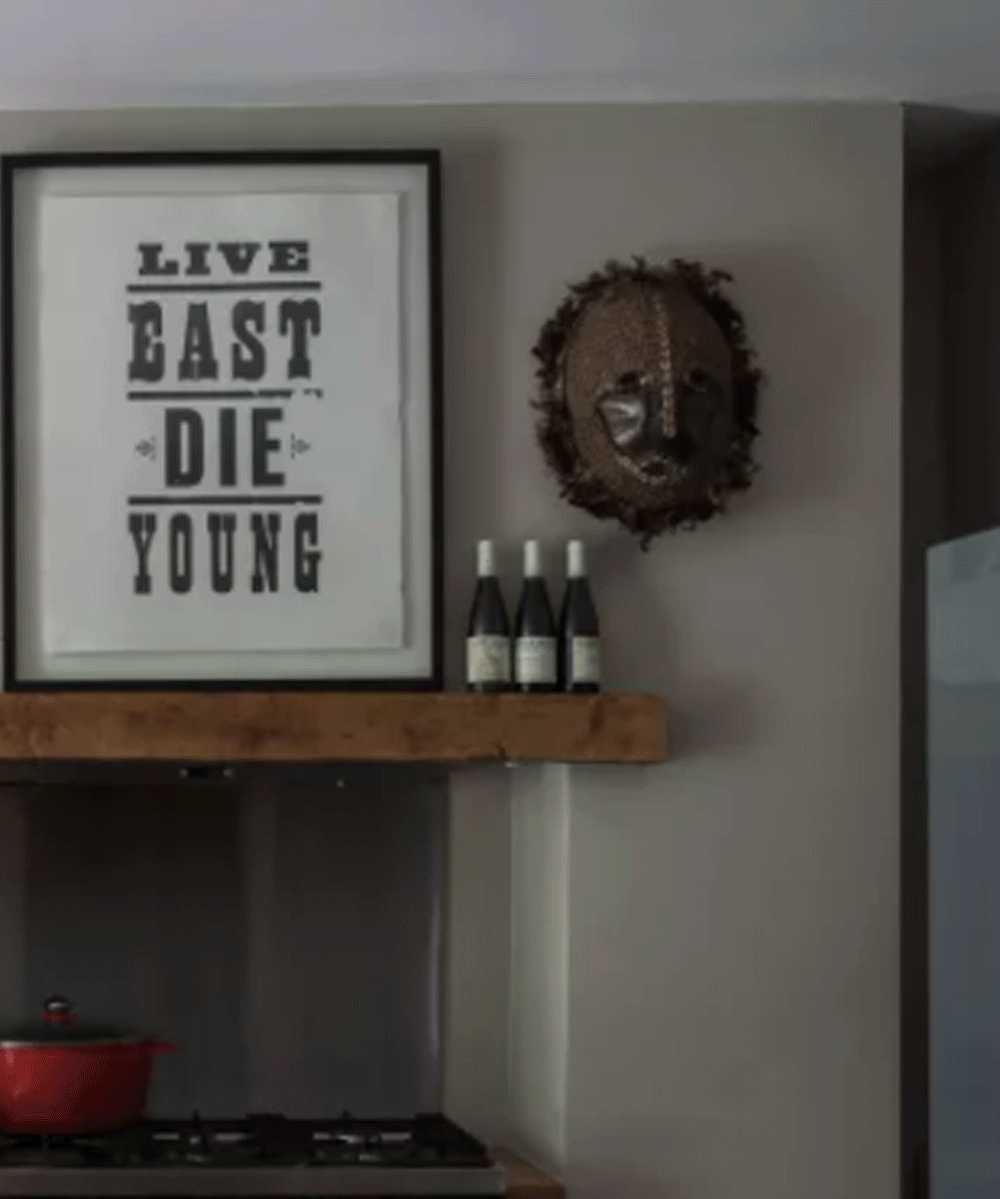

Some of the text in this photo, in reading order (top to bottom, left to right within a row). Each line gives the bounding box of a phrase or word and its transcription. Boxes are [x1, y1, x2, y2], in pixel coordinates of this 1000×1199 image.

[138, 240, 309, 276] LIVE
[128, 298, 321, 382] EAST
[164, 407, 285, 488] DIE
[128, 512, 322, 594] YOUNG
